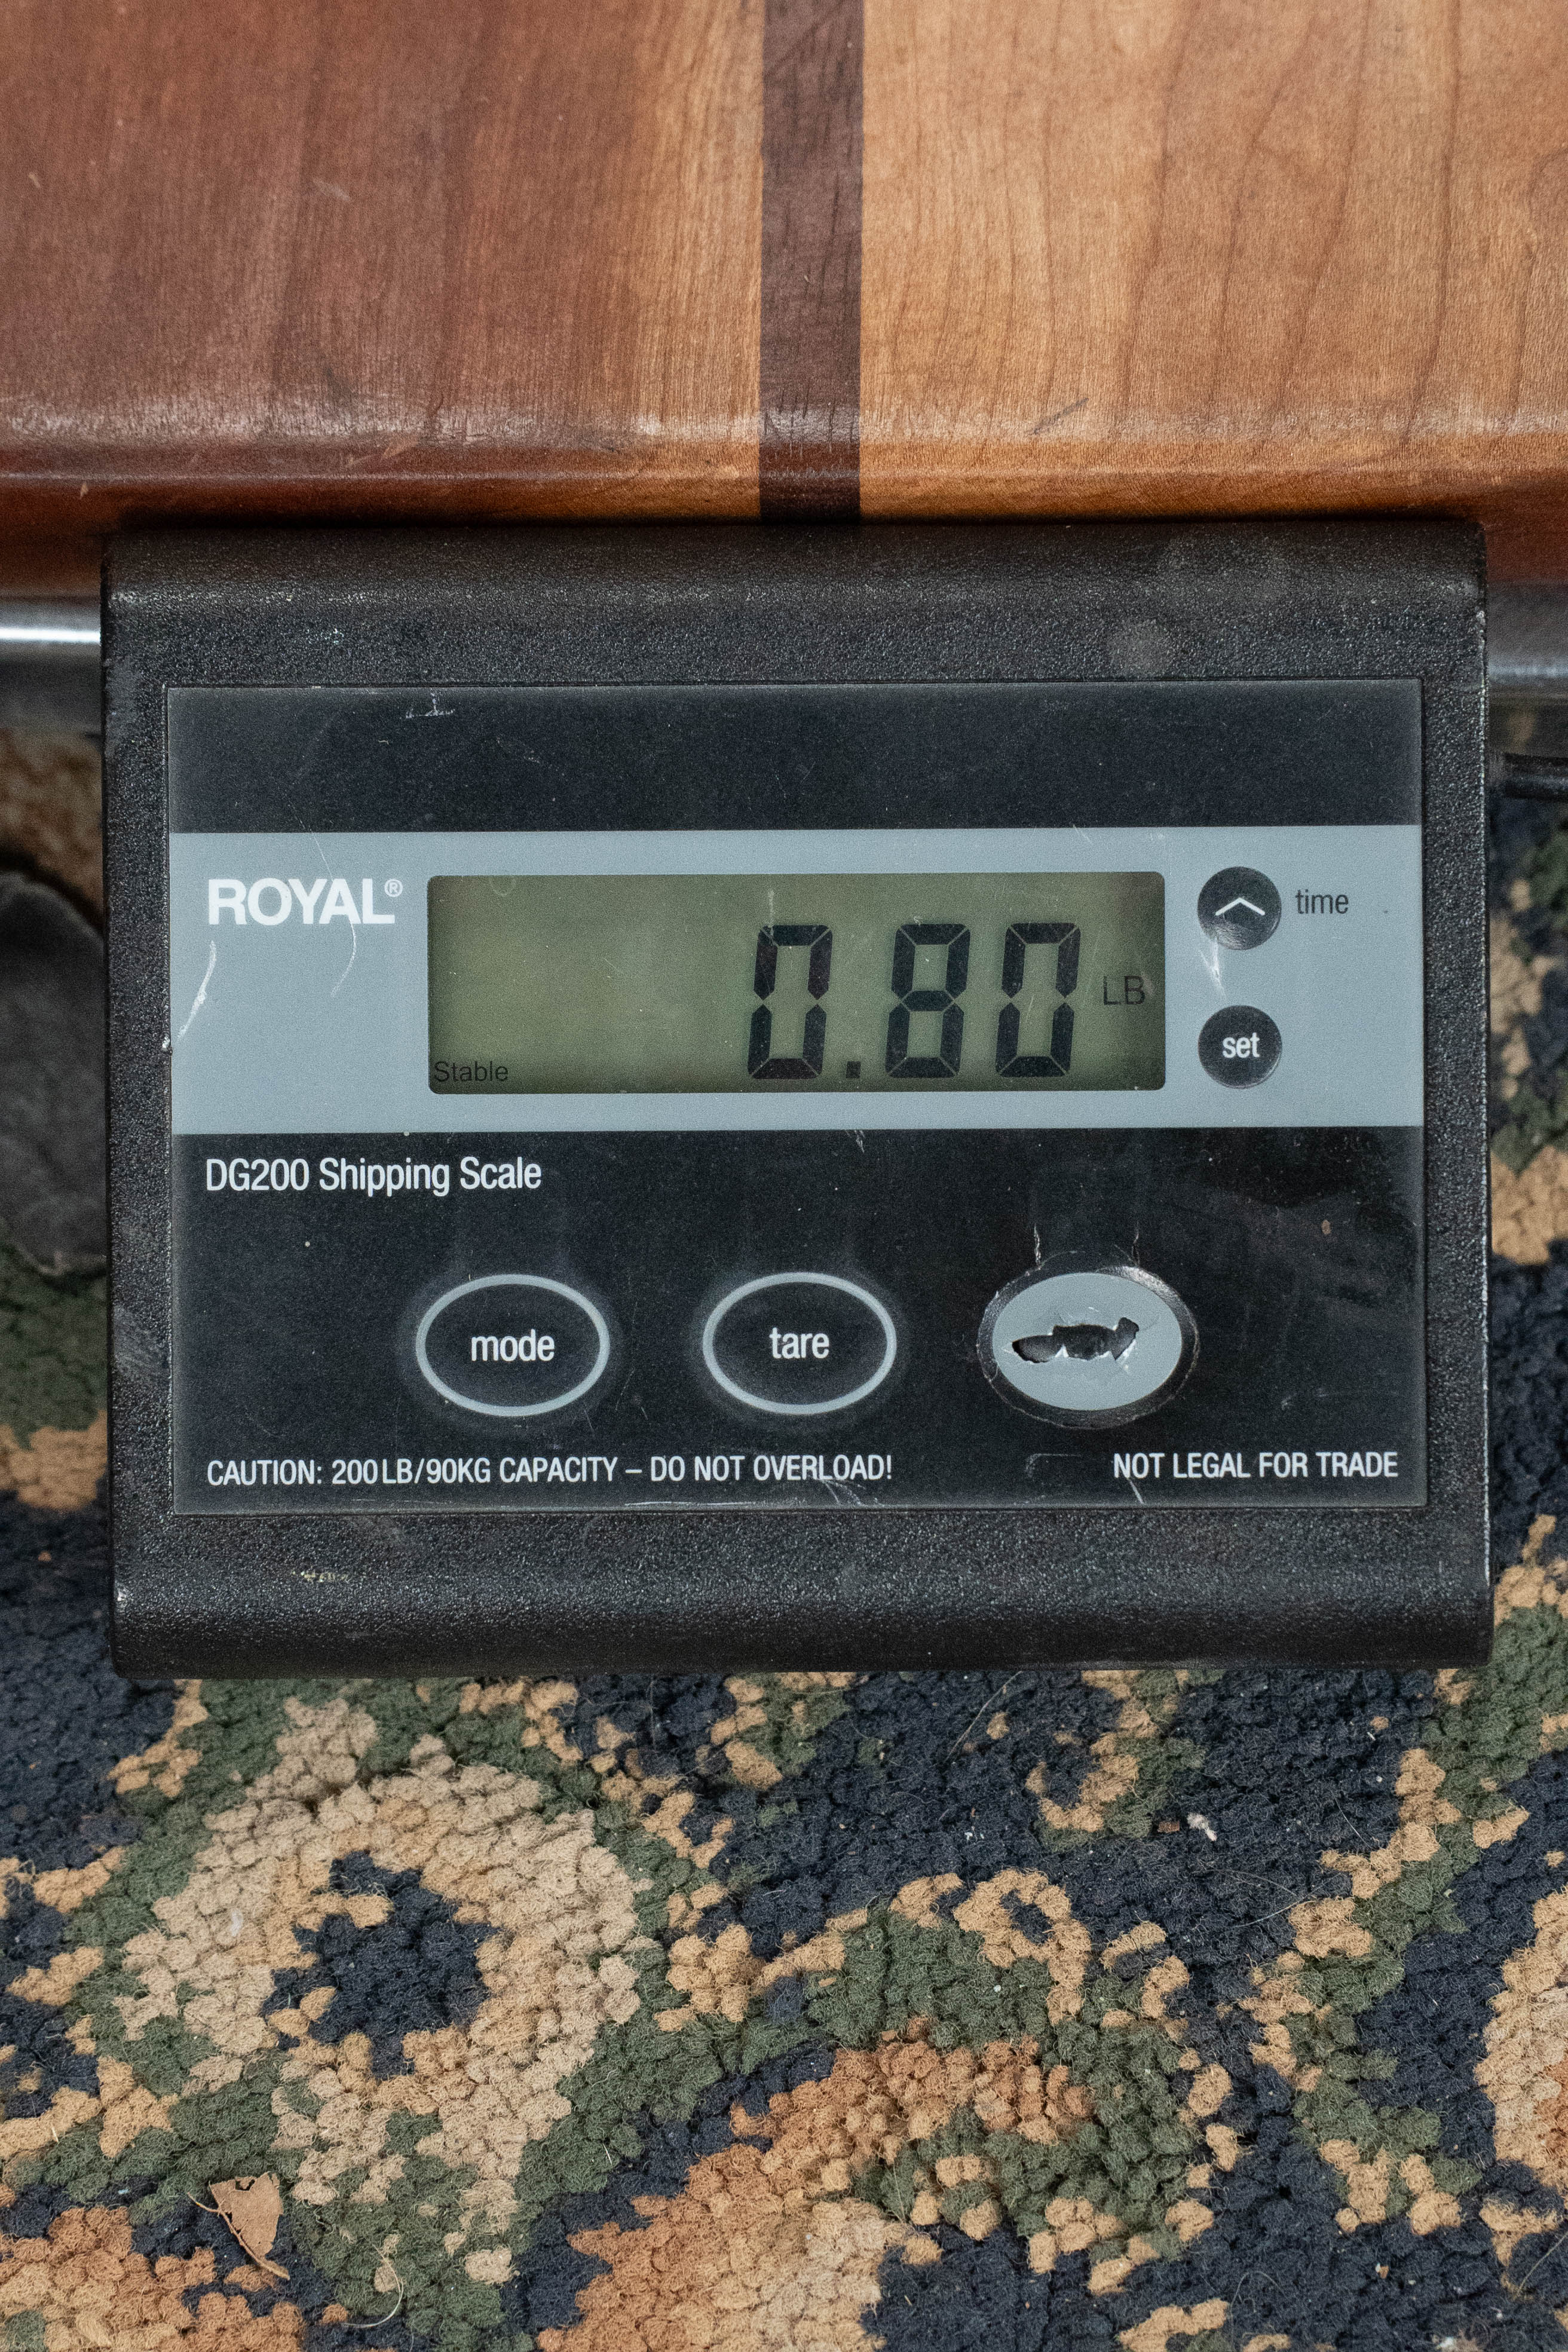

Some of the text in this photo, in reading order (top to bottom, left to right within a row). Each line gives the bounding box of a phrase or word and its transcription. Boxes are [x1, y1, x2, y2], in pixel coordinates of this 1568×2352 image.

[1296, 890, 1349, 915] time
[747, 922, 1146, 1079] 0.80 LB
[1222, 1033, 1261, 1059] set
[434, 1060, 509, 1083] Stable
[206, 1156, 542, 1196] DG200 Shipping Scale
[470, 1330, 555, 1362] mode
[769, 1327, 831, 1359] tare
[207, 1459, 323, 1486] CAUTION:
[499, 1456, 617, 1483] CAPACITY
[650, 1456, 685, 1481] DO
[693, 1456, 745, 1481] NOT
[753, 1454, 893, 1480] OVERLOAD!
[1113, 1452, 1398, 1479] NOT LEGAL FOR TRADE
